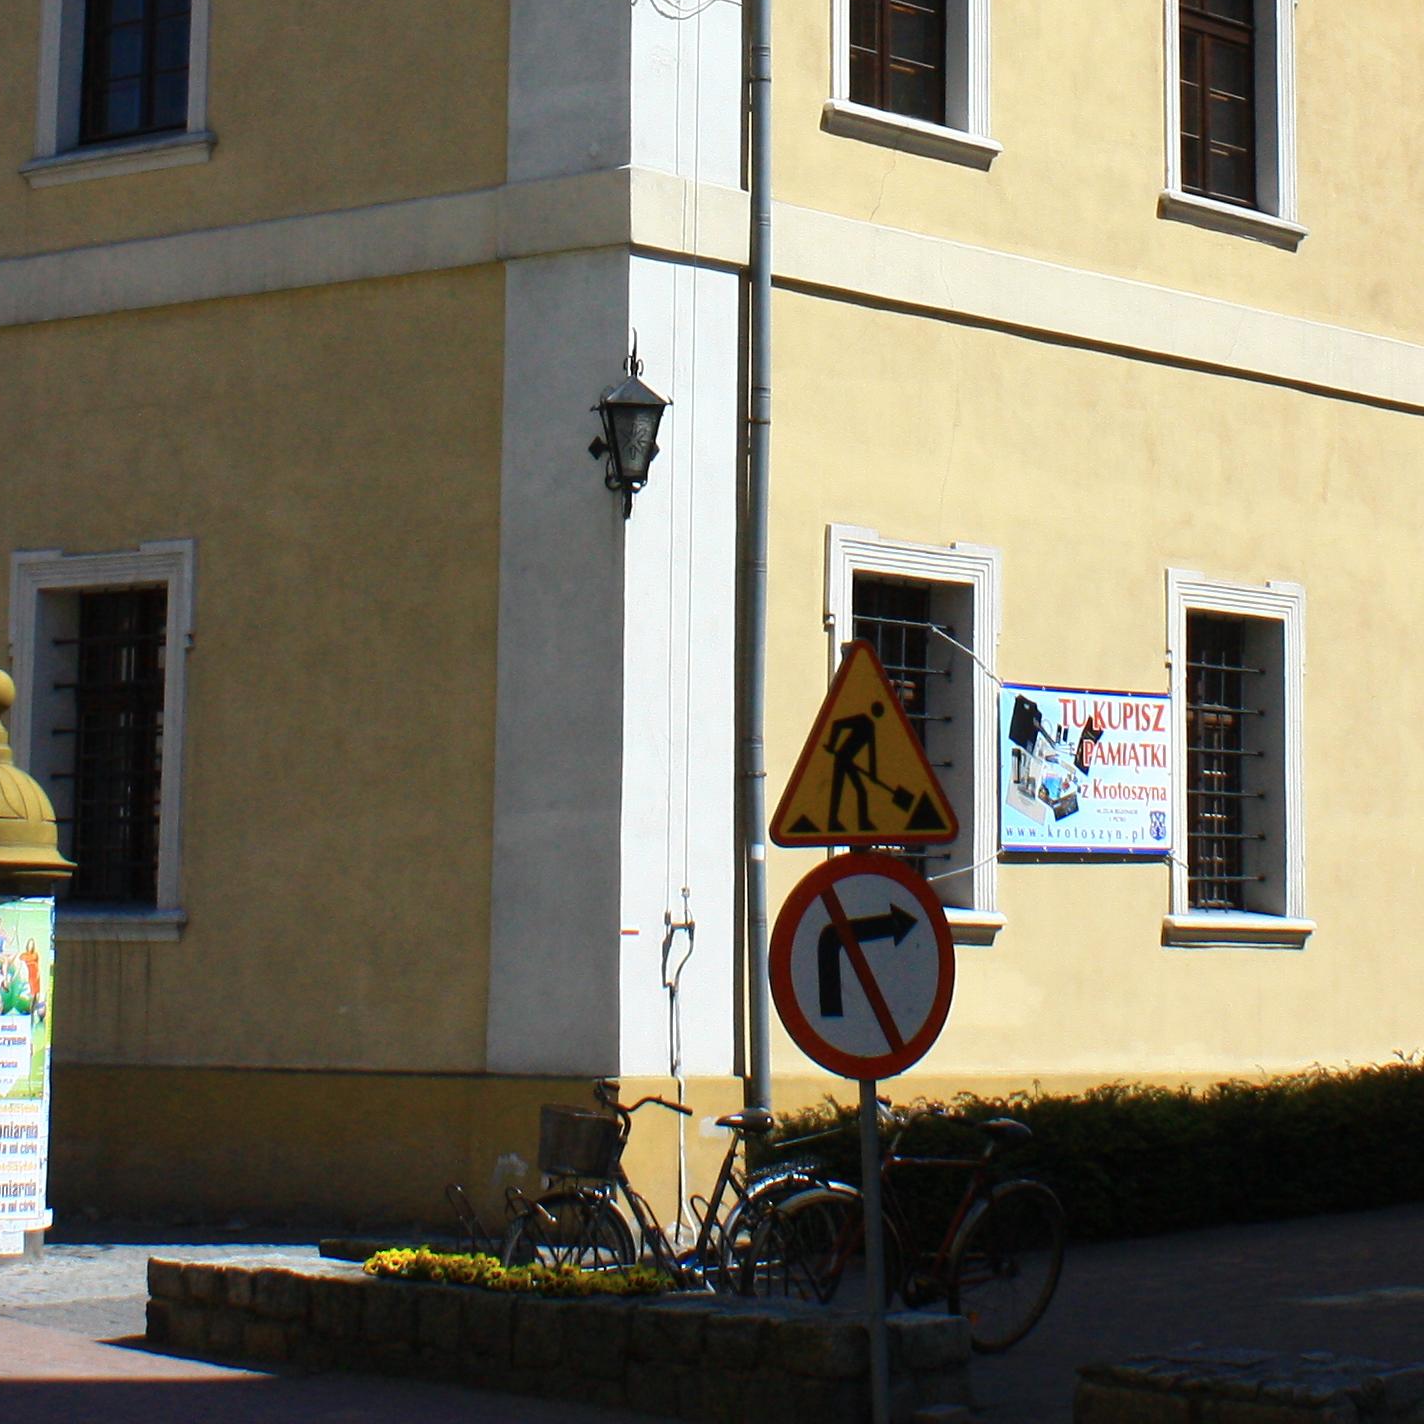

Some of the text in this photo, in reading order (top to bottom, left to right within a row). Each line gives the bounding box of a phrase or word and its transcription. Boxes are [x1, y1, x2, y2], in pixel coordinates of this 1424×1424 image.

[1058, 698, 1166, 732] TU KUPISZ
[1083, 739, 1167, 773] PAMIĄTKI
[1081, 779, 1167, 806] z Krotoszyna
[1006, 825, 1145, 843] www.krotoszyn.pl
